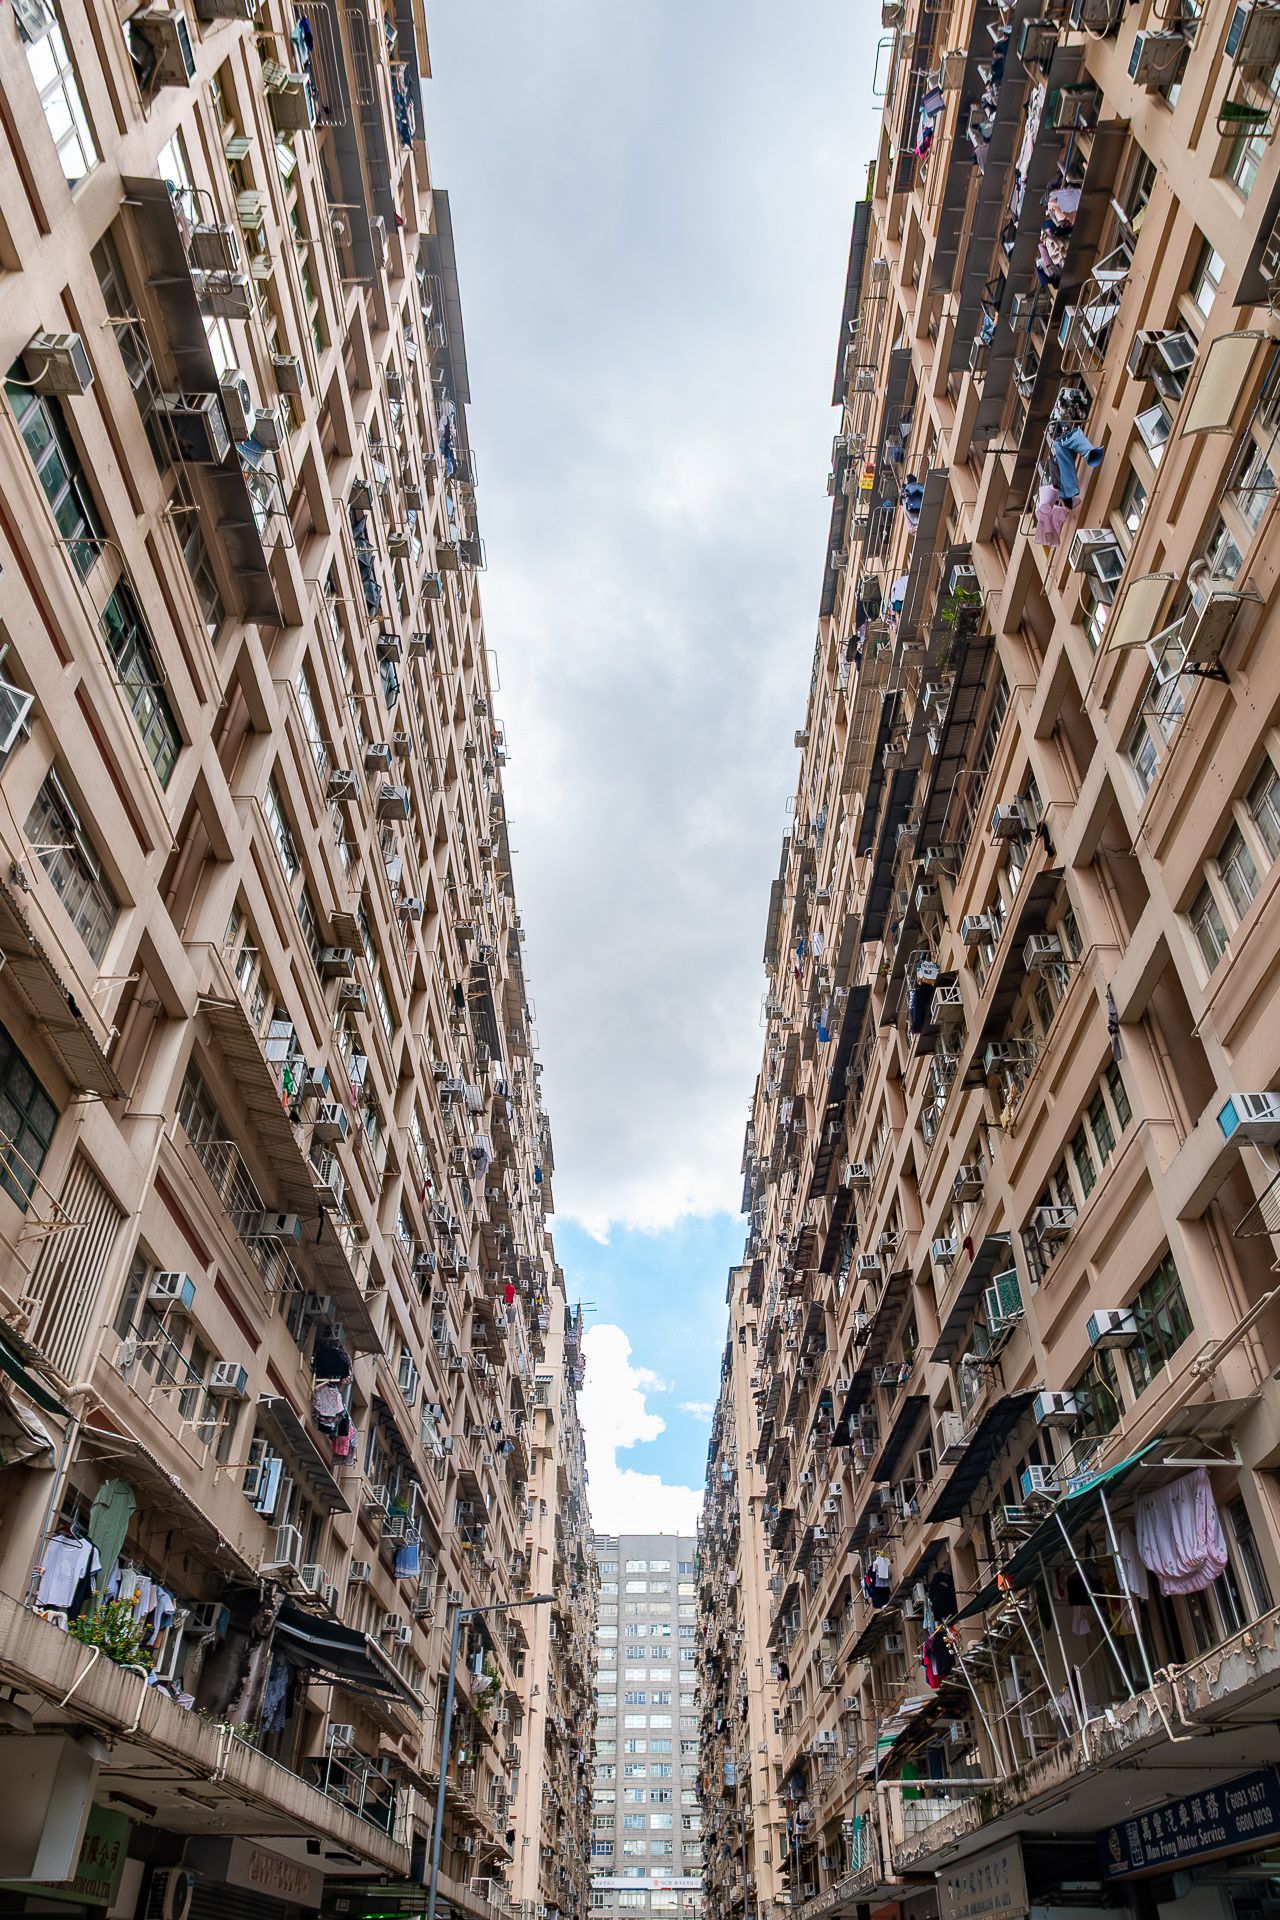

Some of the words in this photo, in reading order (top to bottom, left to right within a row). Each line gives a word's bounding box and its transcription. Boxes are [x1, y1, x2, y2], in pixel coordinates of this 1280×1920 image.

[1230, 1789, 1248, 1810] 6093
[1248, 1782, 1266, 1804] 1617
[1141, 1792, 1219, 1841] 萬豐汽車服務
[1235, 1811, 1254, 1832] 6600
[1253, 1806, 1273, 1828] 0039
[1146, 1844, 1160, 1860] Man
[1161, 1839, 1178, 1858] Fung
[1176, 1834, 1198, 1852] Motor
[1198, 1824, 1226, 1846] Service
